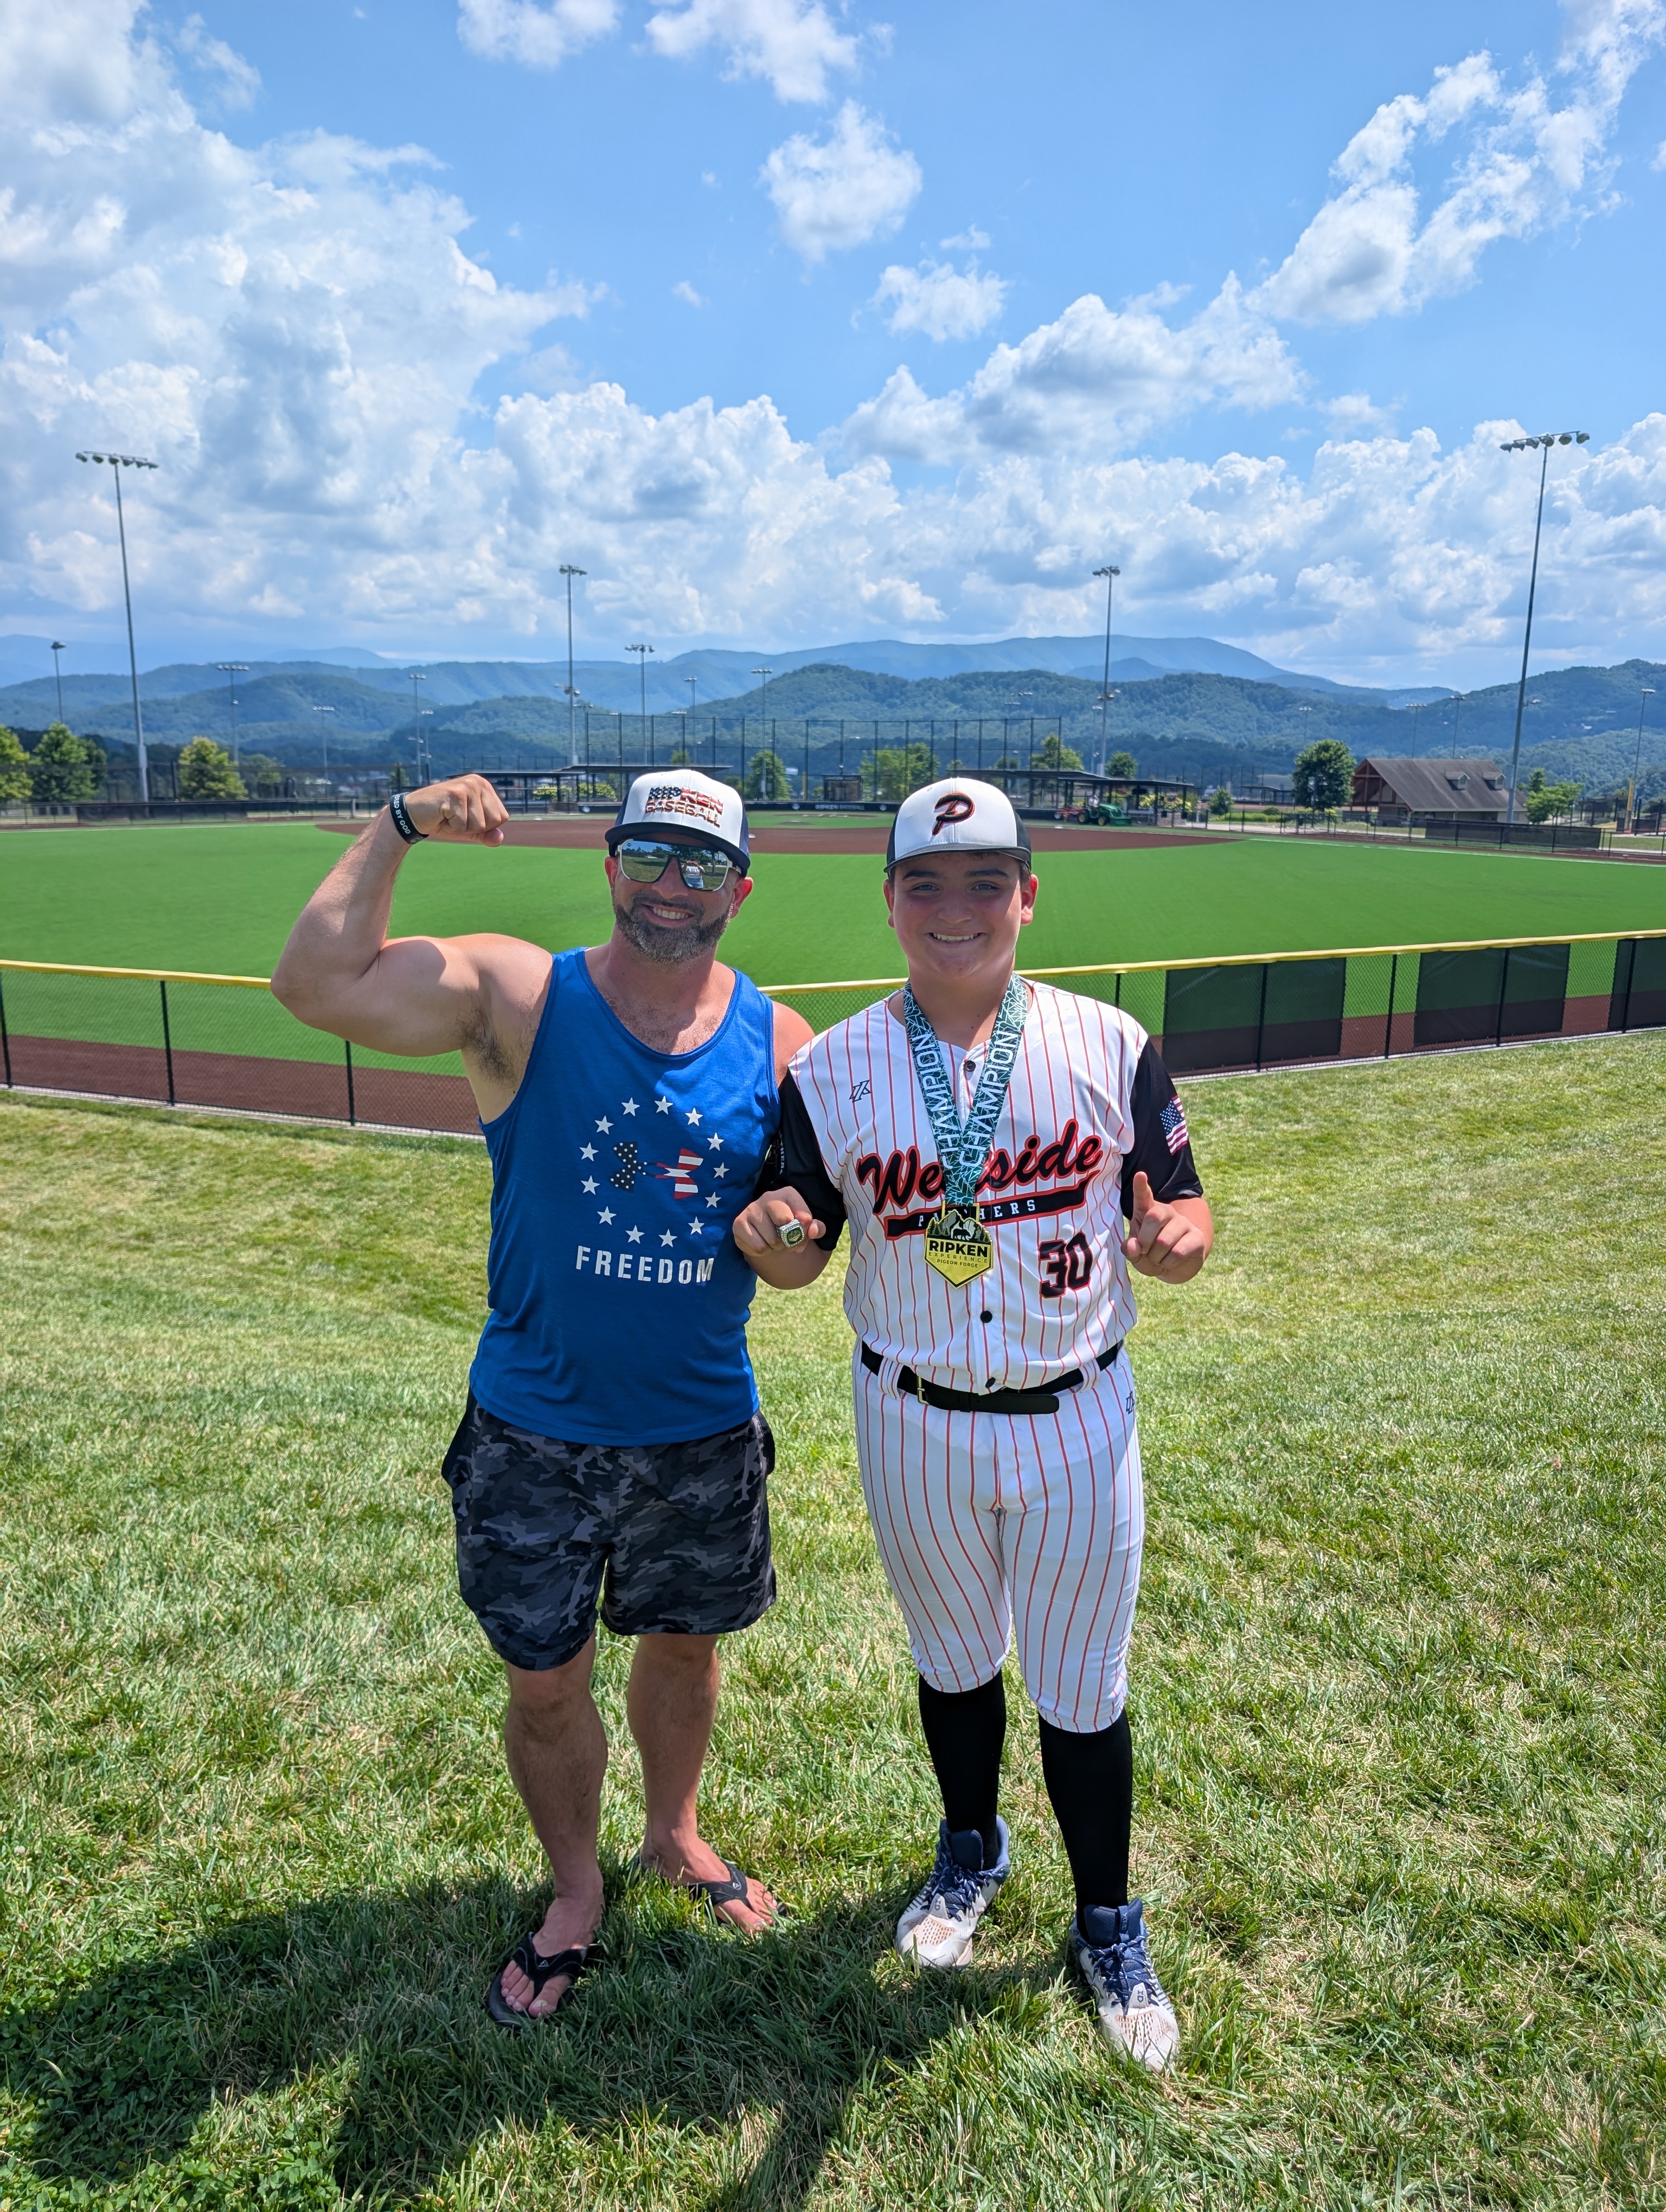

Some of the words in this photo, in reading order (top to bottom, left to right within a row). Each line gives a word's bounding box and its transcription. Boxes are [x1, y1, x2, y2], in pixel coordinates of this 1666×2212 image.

[645, 799, 720, 828] BASEBALL
[649, 786, 724, 815] RIPKEN
[932, 792, 975, 835] P
[395, 809, 403, 818] BY
[400, 820, 411, 834] GOD
[959, 1031, 1018, 1166] CHAMPION
[857, 1119, 1103, 1215] Weside
[919, 1199, 1035, 1227] PHERS
[928, 1251, 988, 1263] EXPERIENCE
[929, 1240, 988, 1258] RIPKEN
[575, 1245, 714, 1284] FREEDOM
[1039, 1230, 1093, 1298] 30
